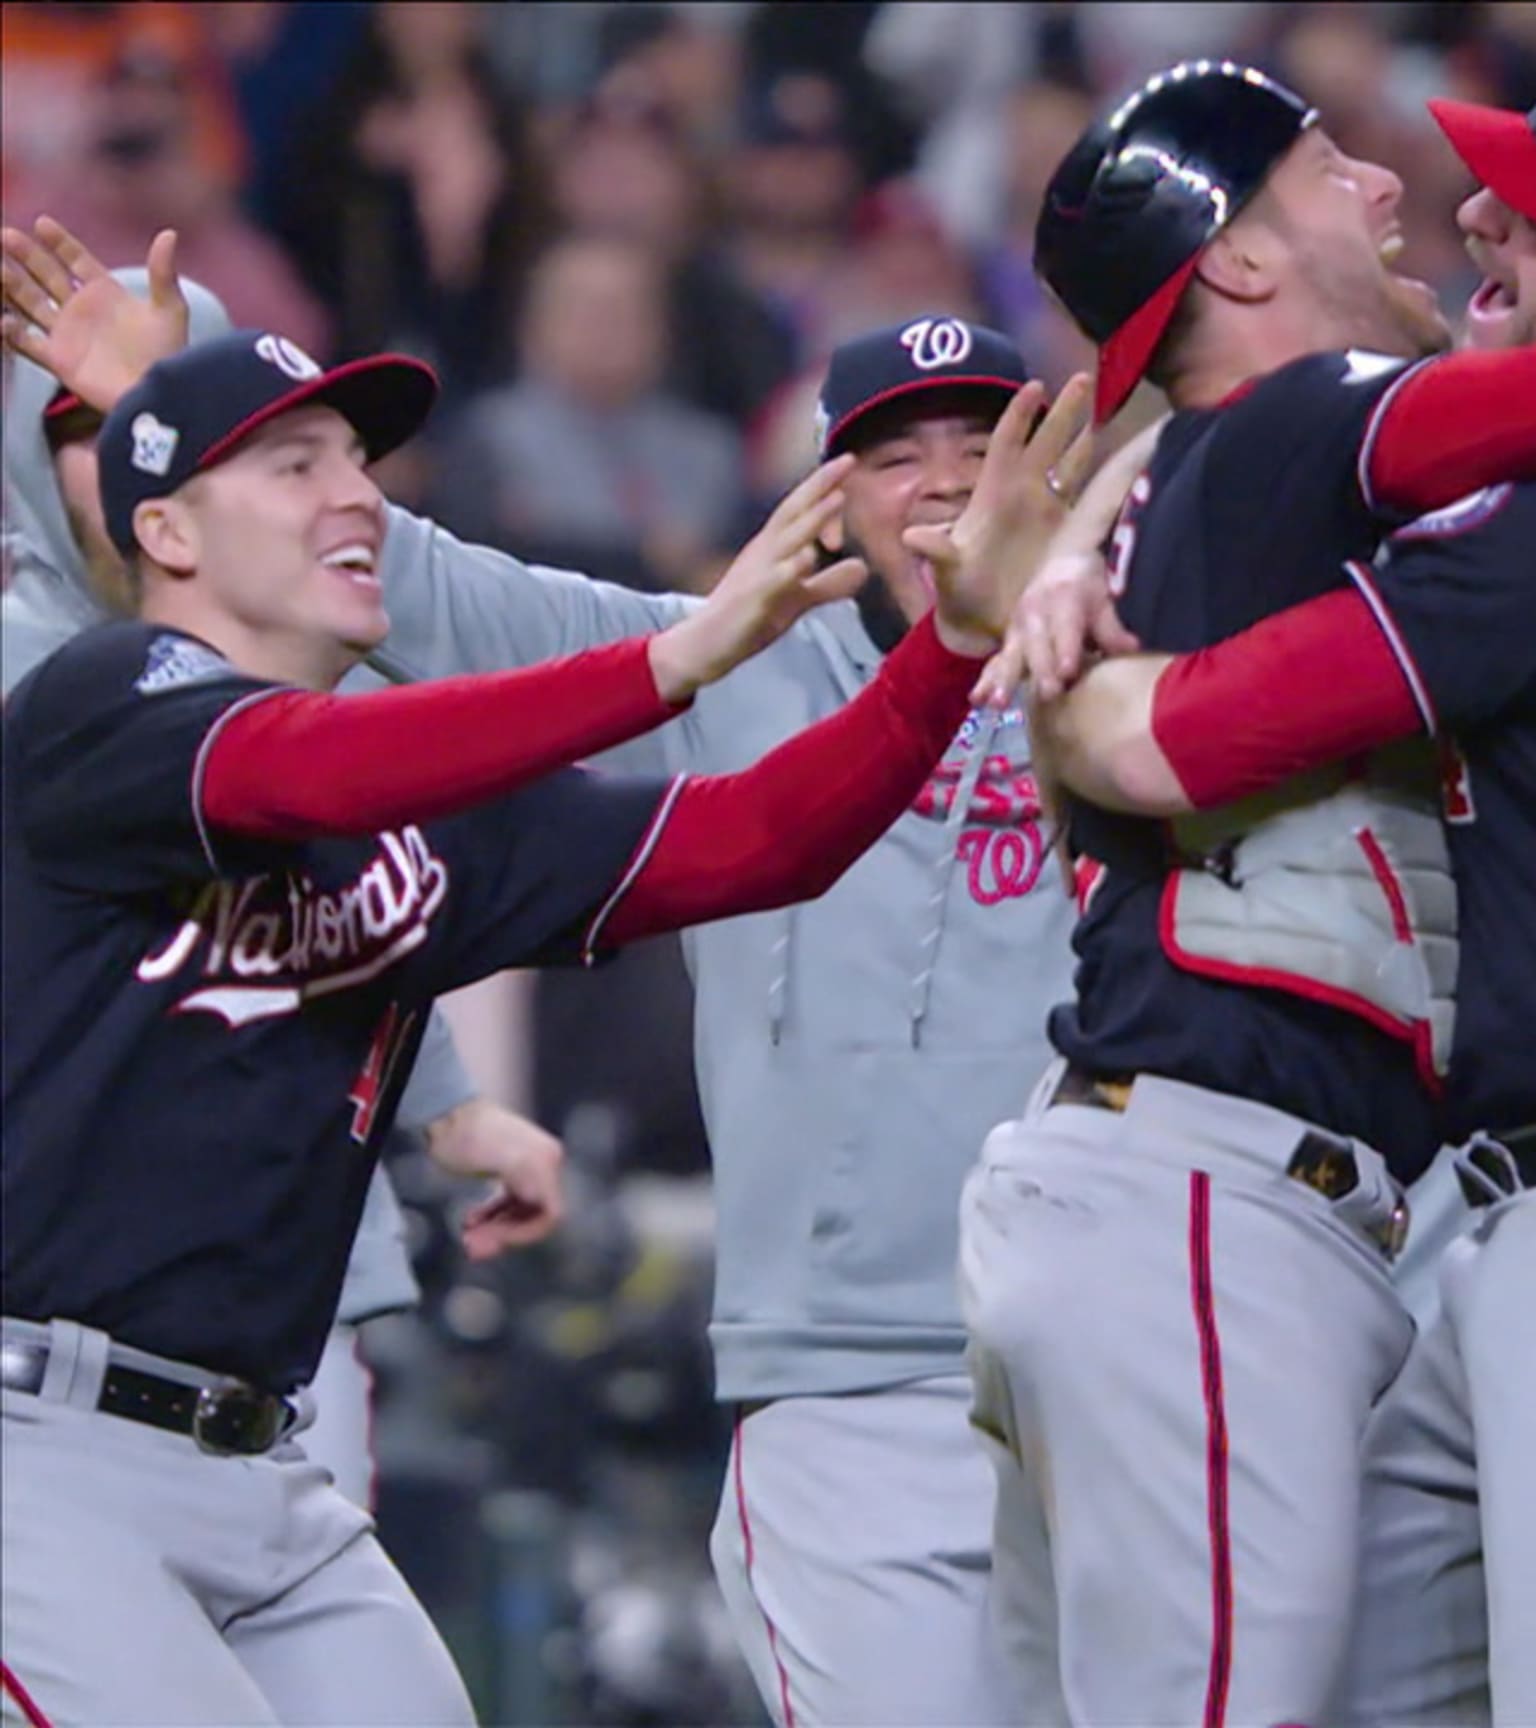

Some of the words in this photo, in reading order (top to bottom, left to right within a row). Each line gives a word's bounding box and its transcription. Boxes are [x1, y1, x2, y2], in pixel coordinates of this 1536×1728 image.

[900, 318, 971, 370] W
[134, 823, 450, 983] Nationals
[954, 819, 1043, 908] W
